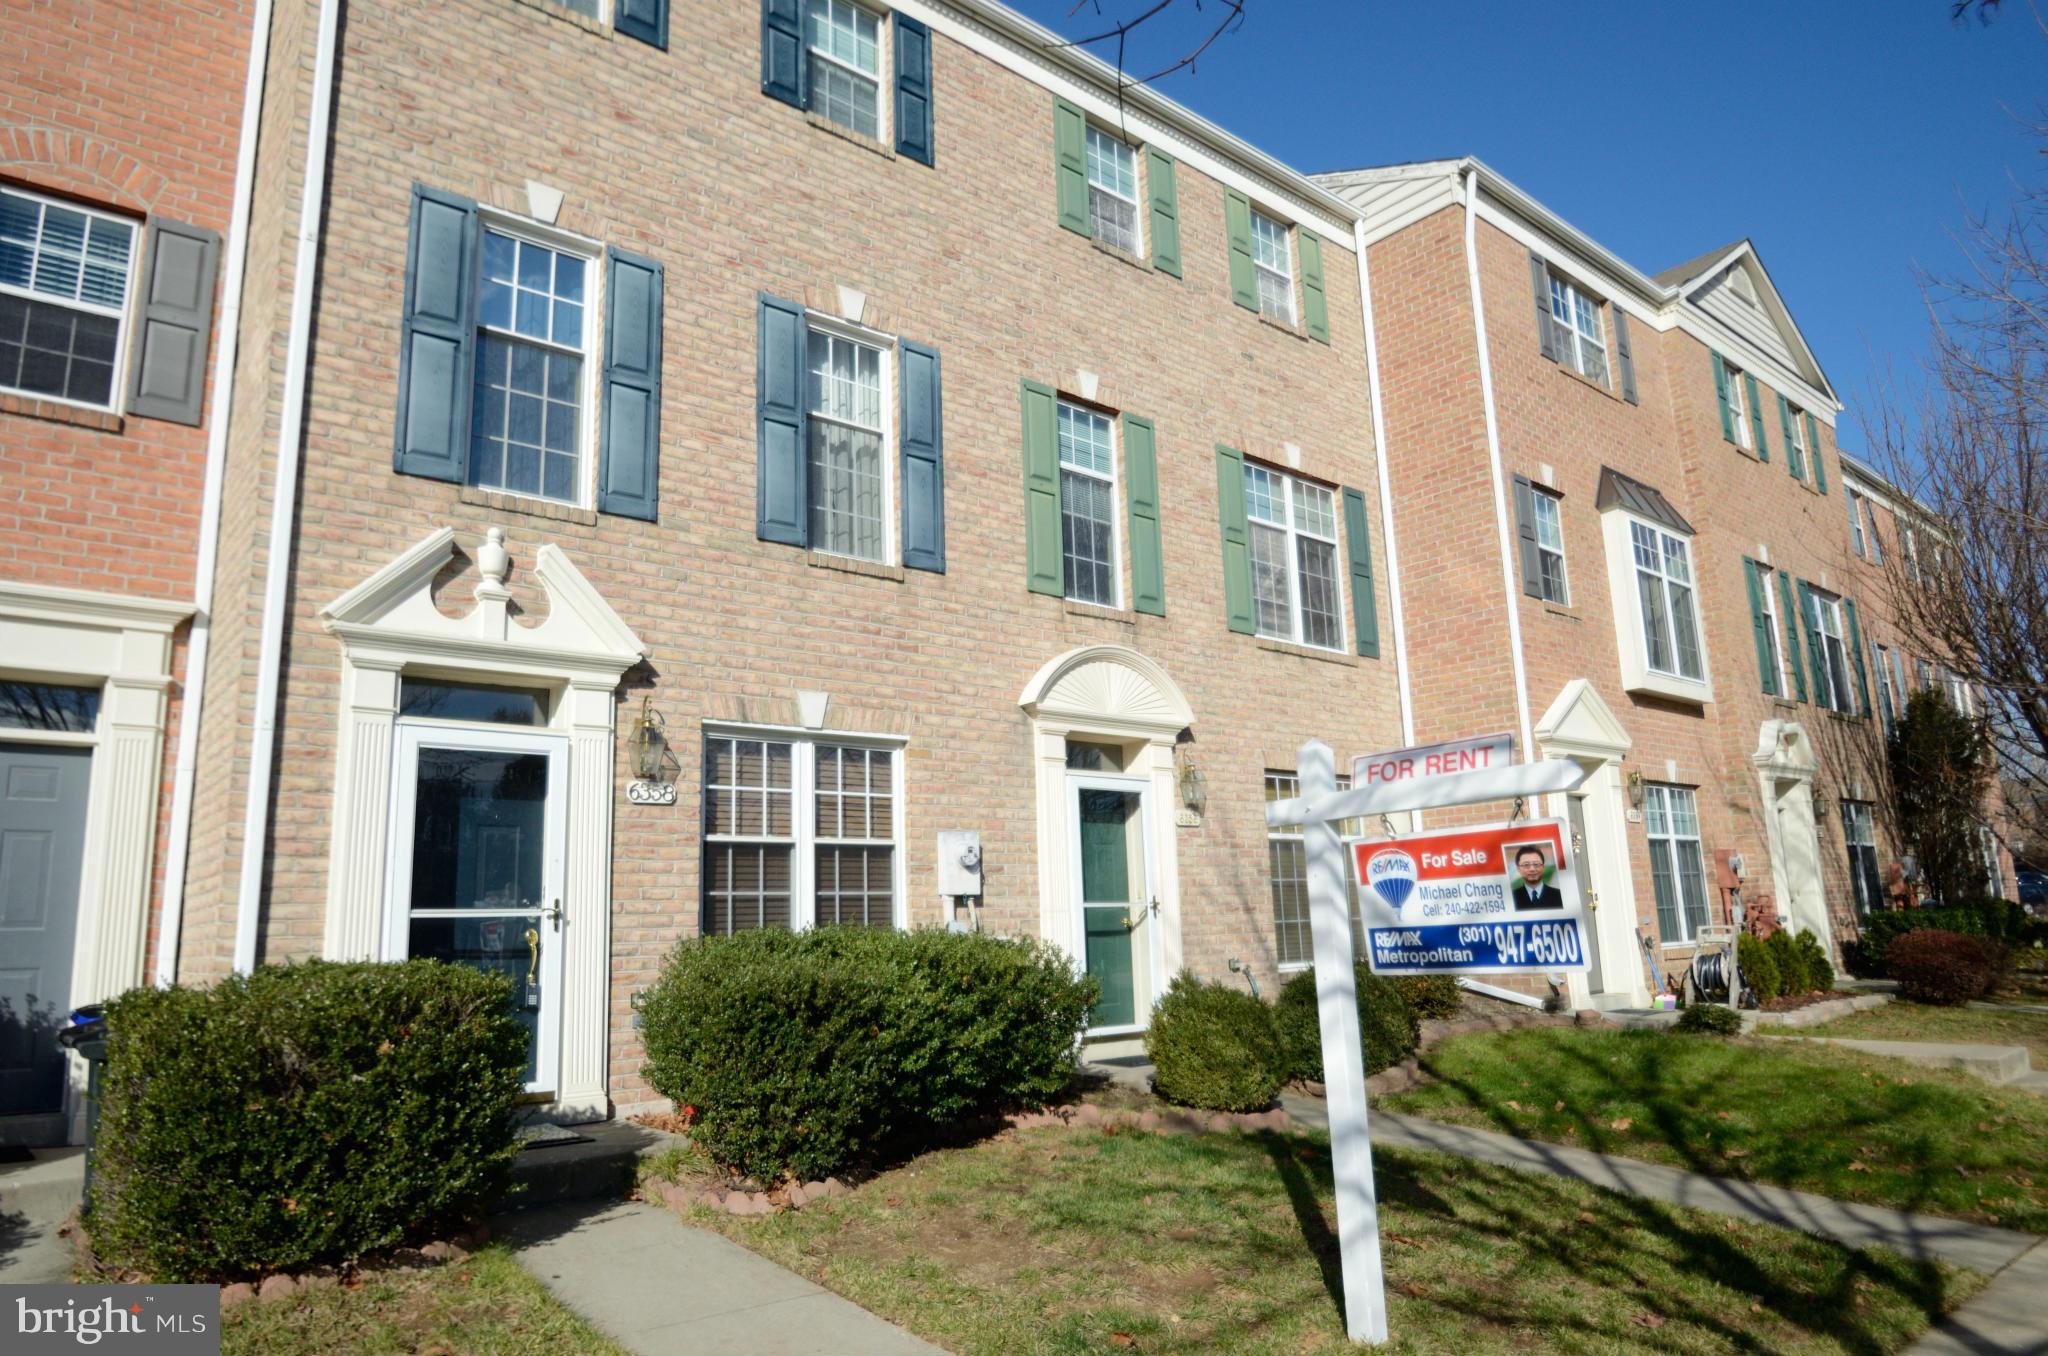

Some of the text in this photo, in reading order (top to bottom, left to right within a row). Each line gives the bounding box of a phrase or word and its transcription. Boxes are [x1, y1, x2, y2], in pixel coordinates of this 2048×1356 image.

[1367, 745, 1494, 784] FOR RENT
[629, 783, 675, 802] 6358
[1372, 858, 1410, 874] RE/MAX
[1421, 849, 1487, 869] For Sale
[1419, 882, 1503, 901] Michael Chang
[1422, 899, 1506, 917] Cell: 240-422-1594
[1374, 930, 1422, 948] RE/MAX
[1458, 922, 1579, 965] (301) 947-6500
[1377, 947, 1474, 966] Metropolitan
